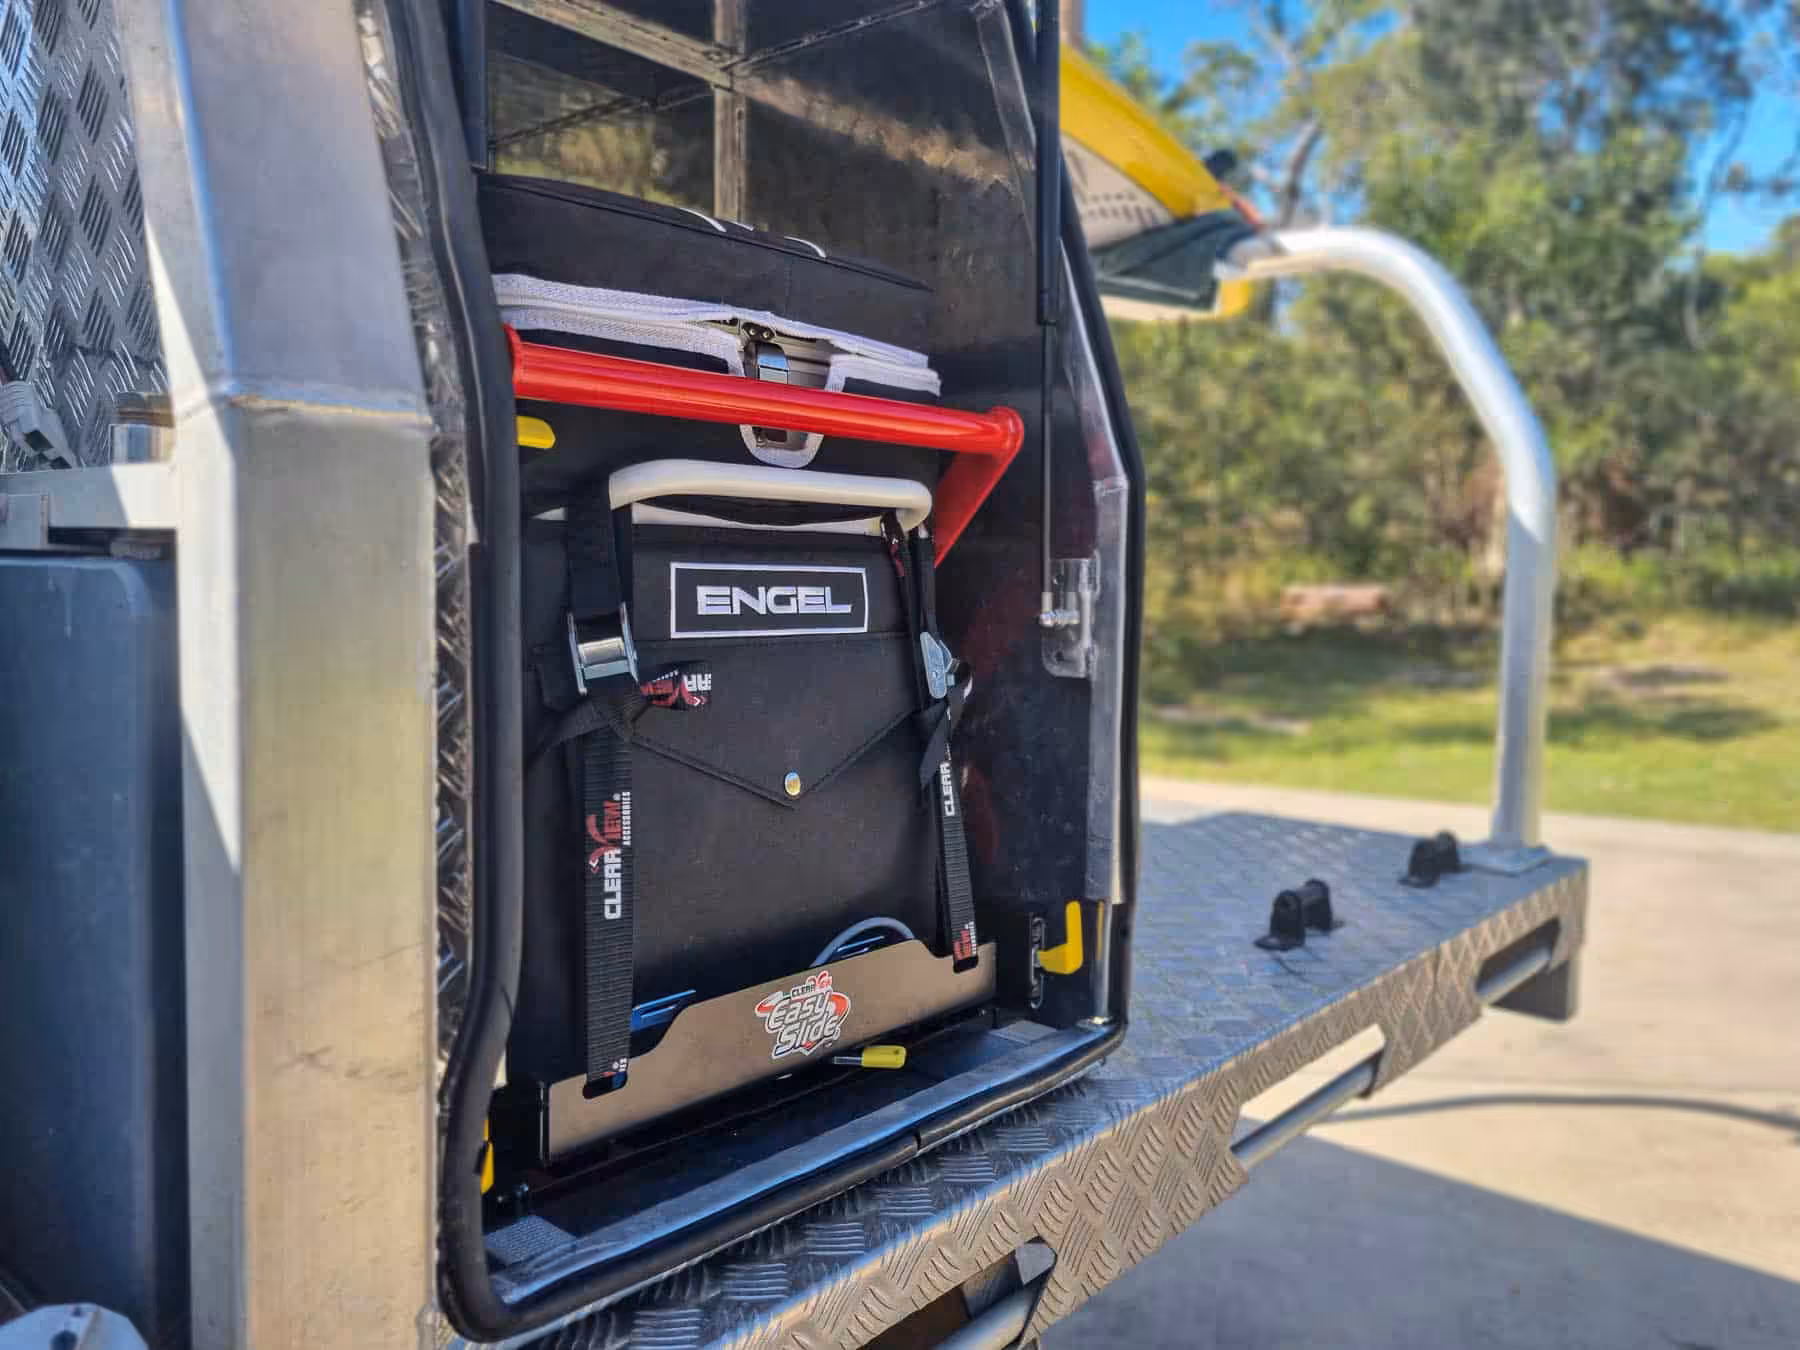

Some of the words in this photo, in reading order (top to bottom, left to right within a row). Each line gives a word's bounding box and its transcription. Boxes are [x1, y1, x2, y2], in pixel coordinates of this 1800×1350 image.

[697, 585, 852, 615] ENGEL
[940, 763, 955, 816] CLEAR
[768, 991, 832, 1031] Easy
[775, 1012, 842, 1056] Slide
